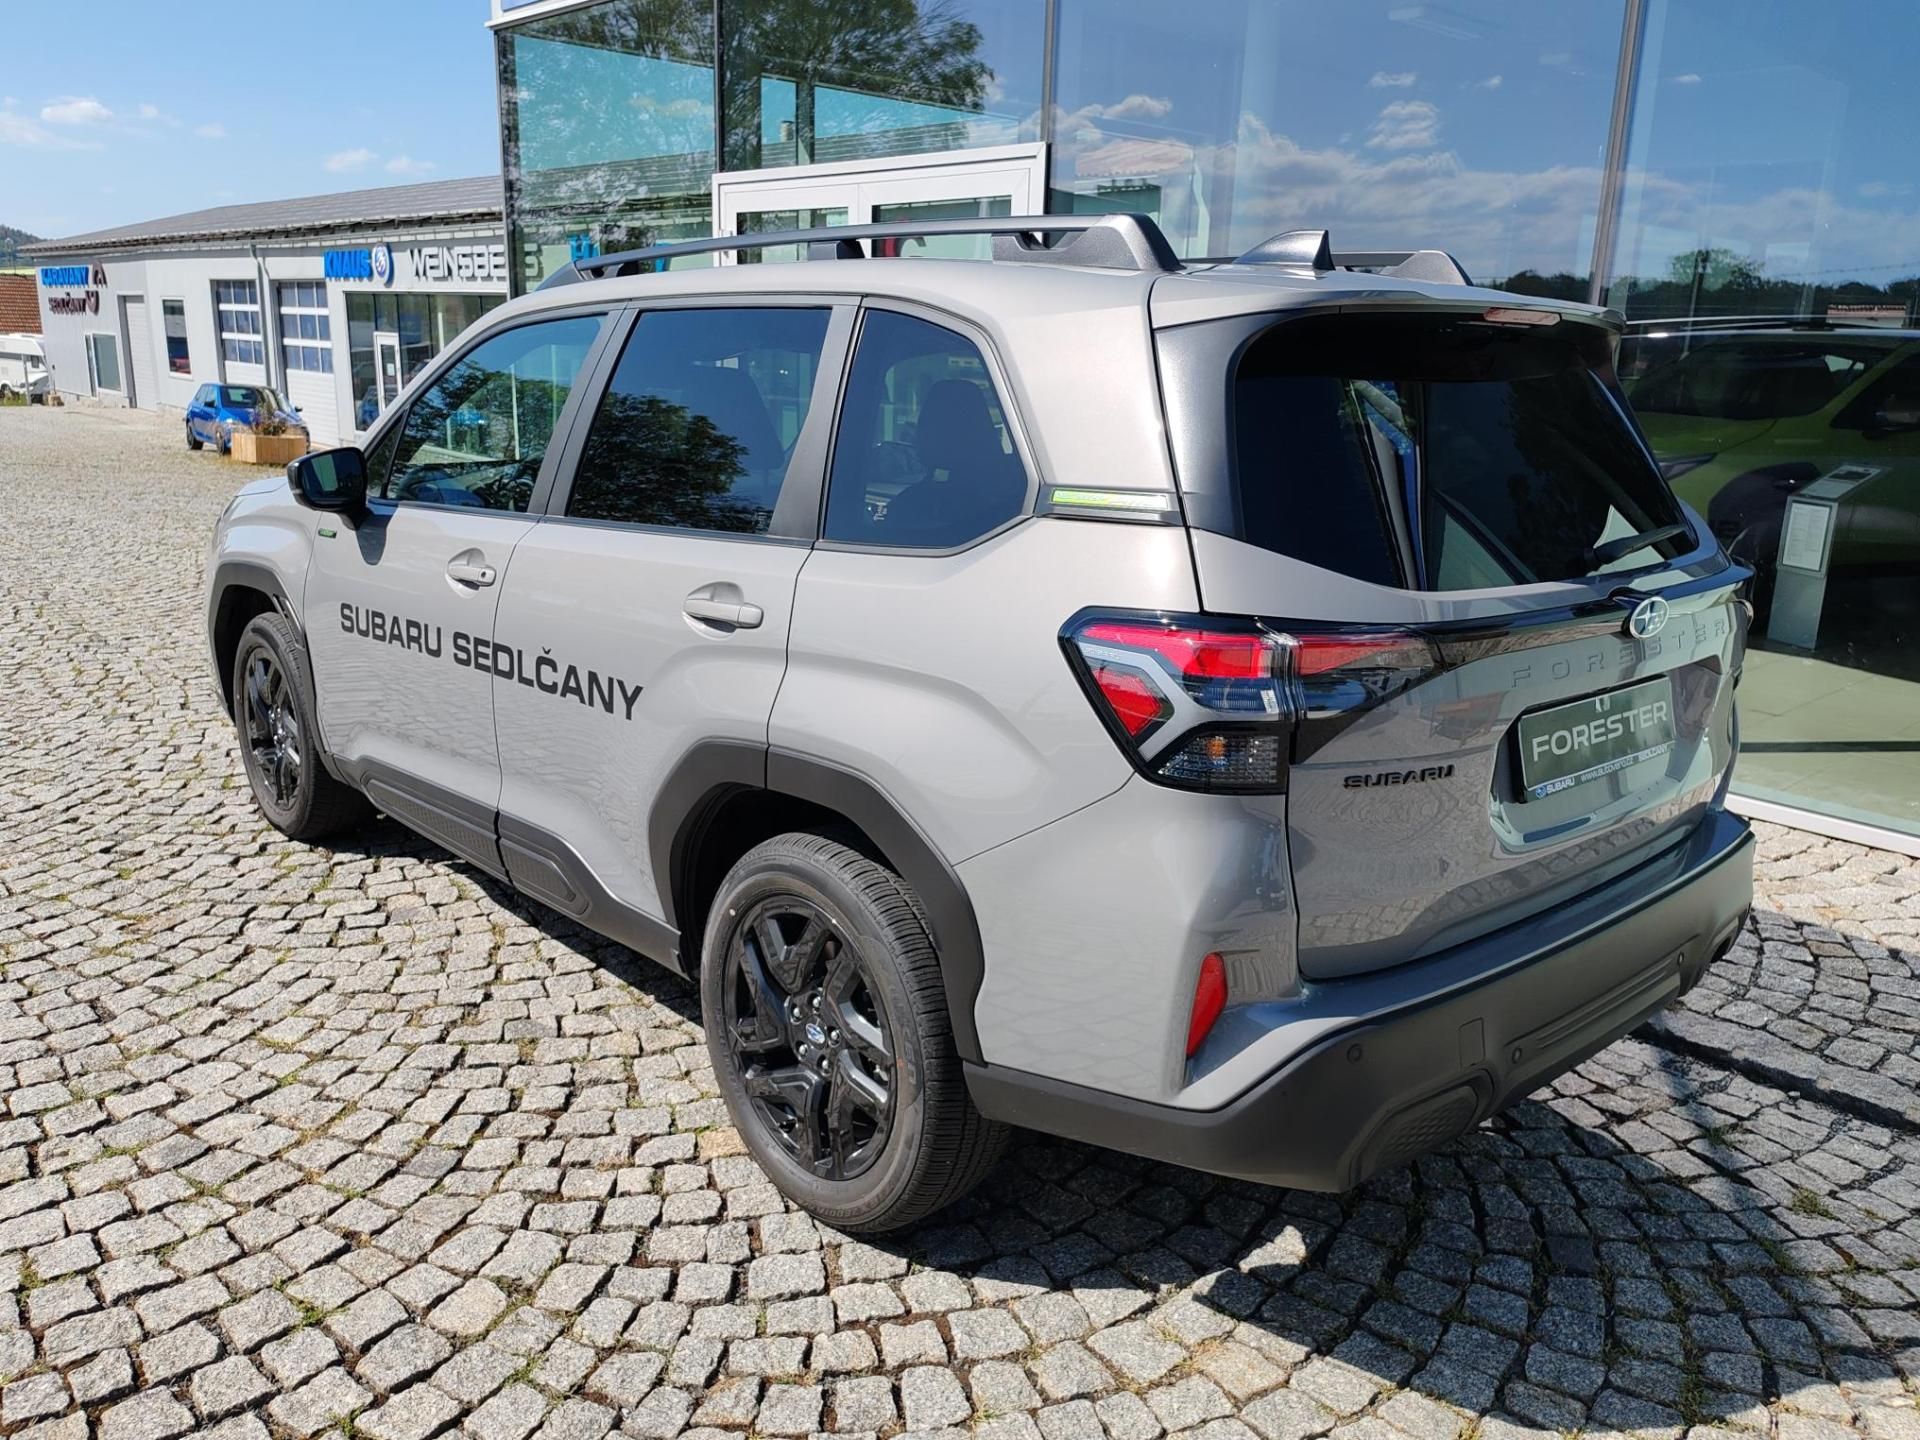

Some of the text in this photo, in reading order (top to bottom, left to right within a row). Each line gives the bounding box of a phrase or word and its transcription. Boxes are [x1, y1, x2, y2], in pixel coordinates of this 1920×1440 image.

[324, 247, 372, 281] KNAUS
[340, 602, 644, 721] SUBARU SEDLČANY
[1511, 619, 1726, 688] FORESTER
[1532, 701, 1668, 762] FORESTER
[1343, 764, 1455, 789] SUBARU
[1546, 777, 1576, 793] SUBARU
